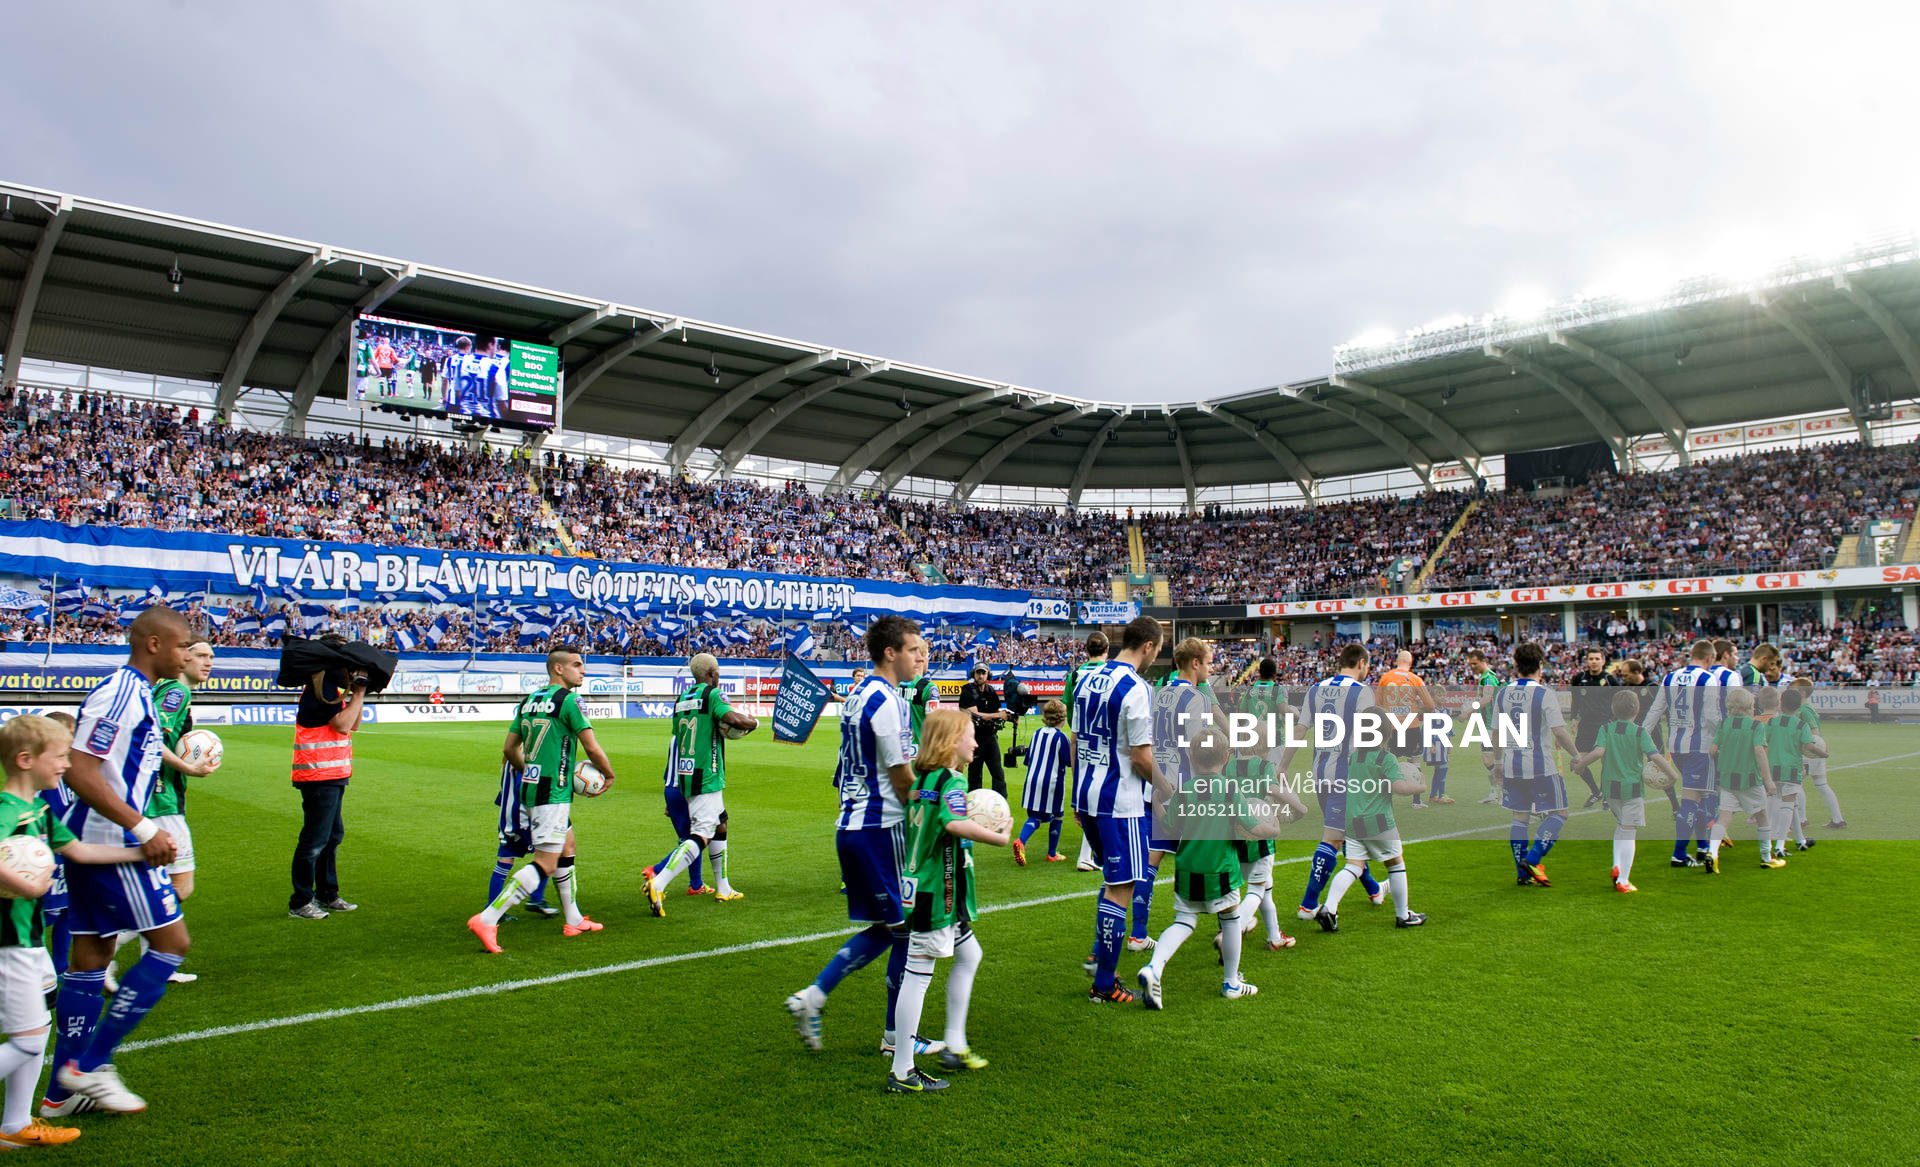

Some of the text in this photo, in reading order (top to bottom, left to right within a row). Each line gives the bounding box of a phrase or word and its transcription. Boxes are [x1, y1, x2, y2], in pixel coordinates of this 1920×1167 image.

[228, 544, 281, 588] VI
[291, 544, 364, 592] ÄR
[374, 552, 556, 597] BLÅVITT
[703, 576, 855, 613] STOLTHET
[1668, 578, 1714, 593] GT
[1756, 573, 1806, 589] GT
[1440, 592, 1477, 606] GT
[1511, 588, 1550, 602] GT
[1586, 583, 1629, 599] GT
[1259, 603, 1288, 616] GT
[1315, 600, 1347, 613] GT
[1375, 597, 1408, 610] GT
[790, 681, 812, 698] HELA
[1088, 676, 1109, 692] KIA
[1322, 687, 1340, 697] KIA
[780, 686, 816, 713] SVERIGES
[1386, 682, 1412, 706] 32
[1508, 692, 1527, 701] KIA
[403, 705, 480, 714] VOLVIA
[777, 697, 812, 722] OTBOLLS
[1674, 686, 1690, 720] 4
[233, 706, 298, 723] Nilfis
[1077, 695, 1112, 746] 14
[521, 718, 551, 761] 27
[679, 717, 697, 756] 21
[1314, 856, 1326, 883] SKF
[1102, 917, 1115, 953] SKF
